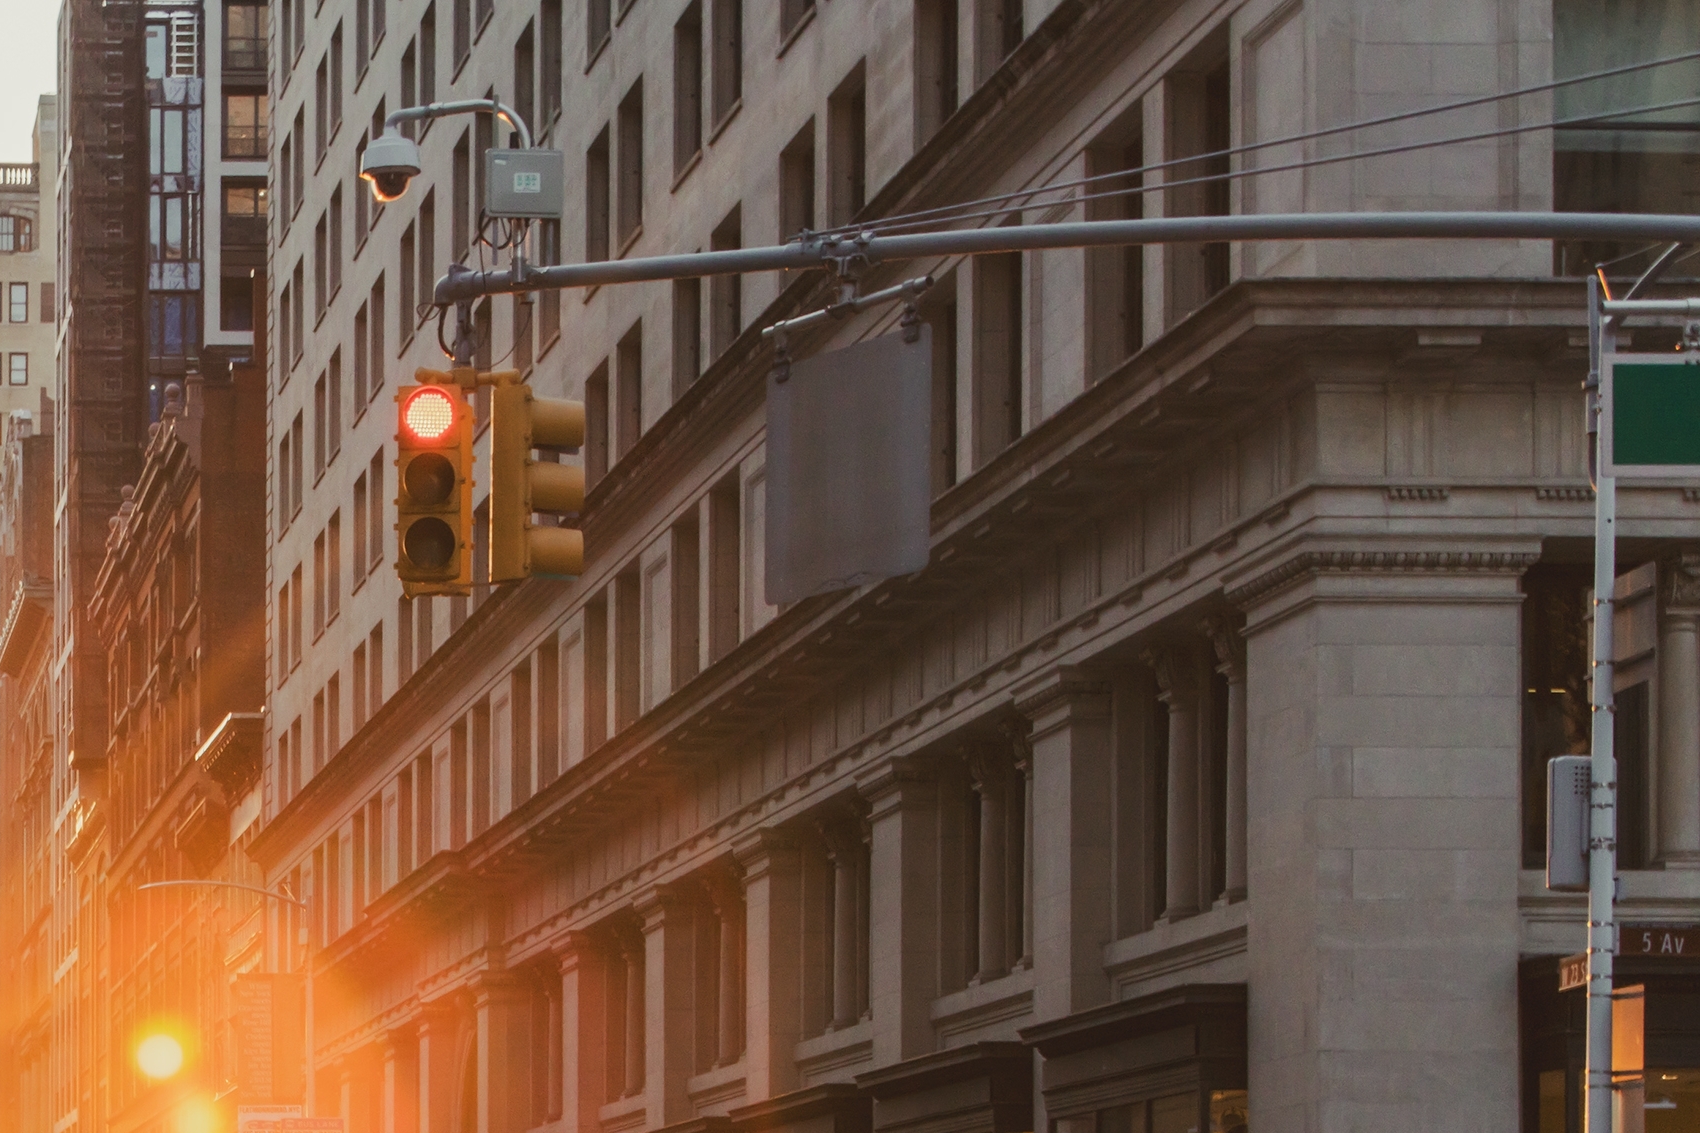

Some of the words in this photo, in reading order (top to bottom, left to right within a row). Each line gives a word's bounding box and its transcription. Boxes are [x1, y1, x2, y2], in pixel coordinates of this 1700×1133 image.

[1642, 932, 1652, 953] 5
[1660, 933, 1685, 954] Av
[1570, 963, 1579, 985] 23
